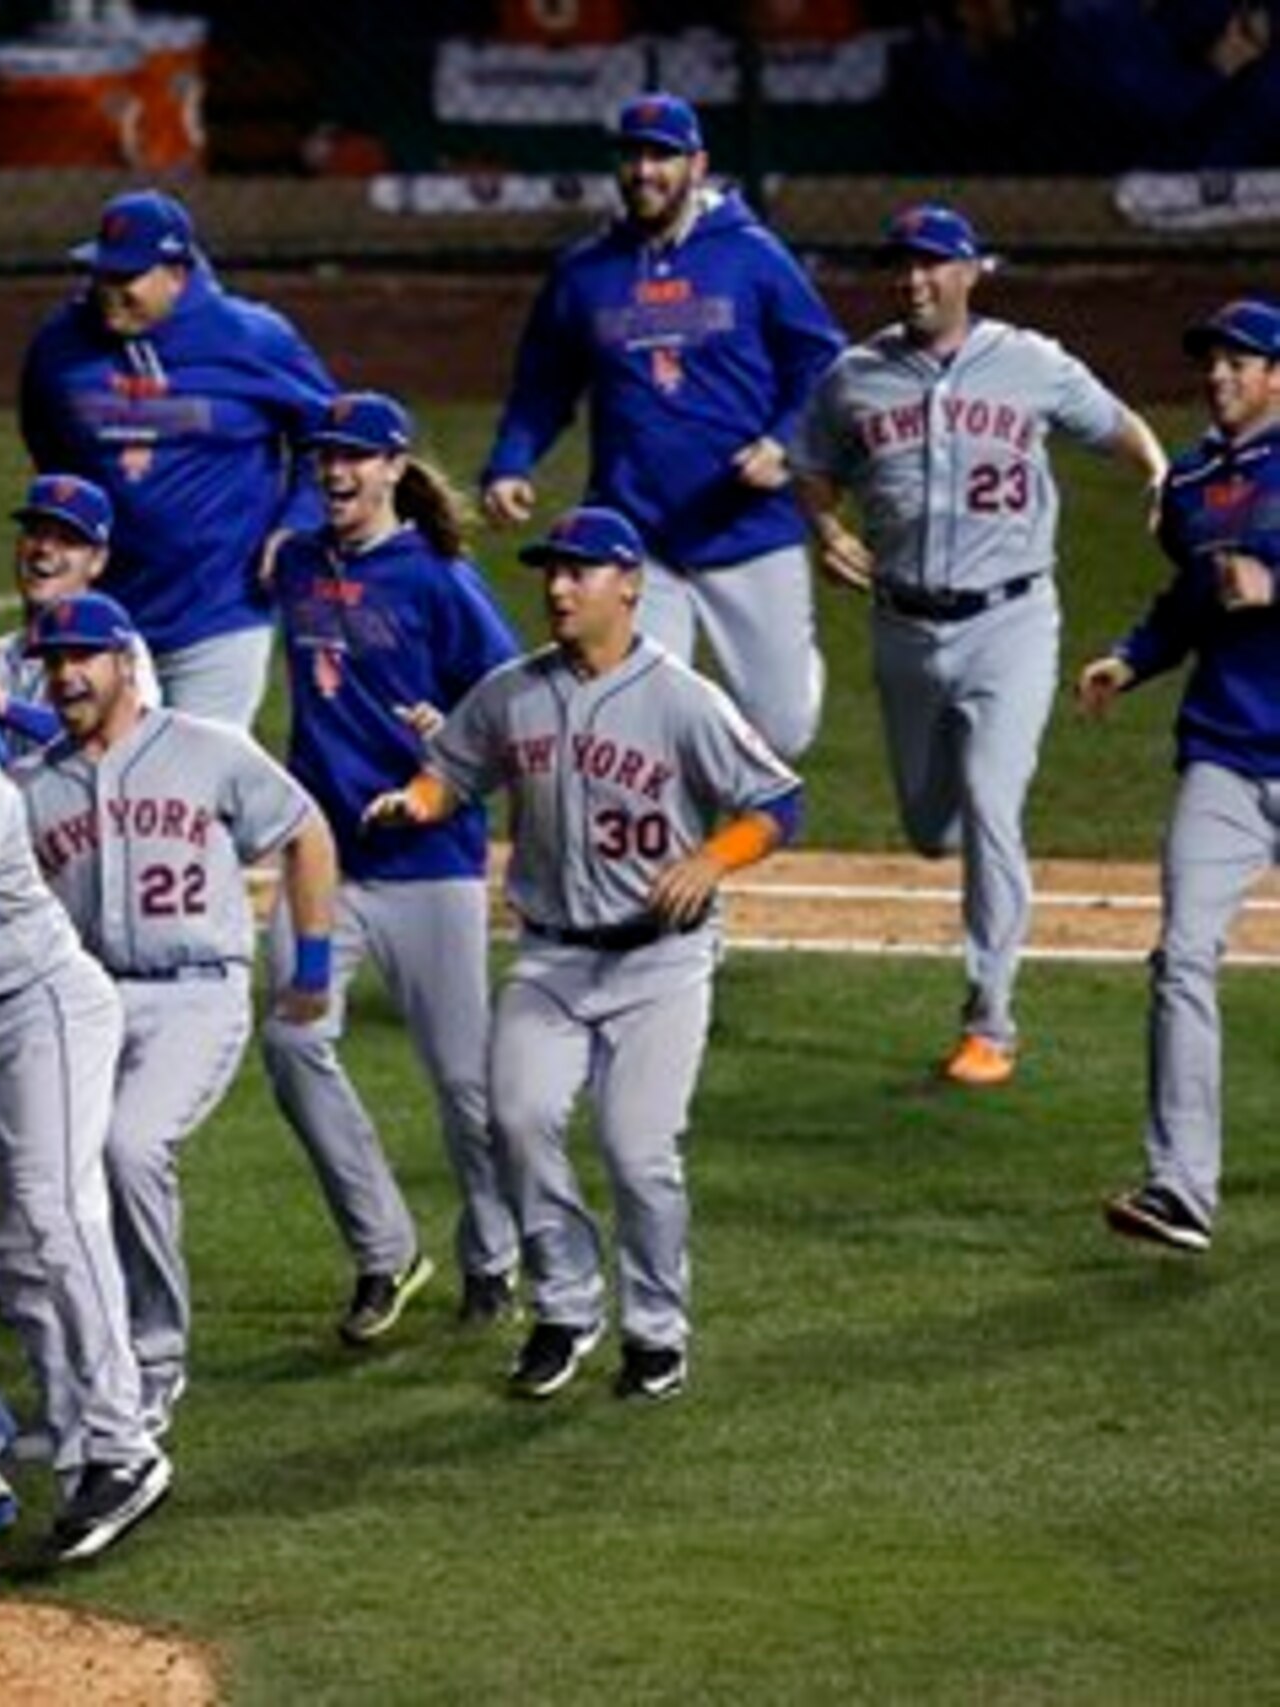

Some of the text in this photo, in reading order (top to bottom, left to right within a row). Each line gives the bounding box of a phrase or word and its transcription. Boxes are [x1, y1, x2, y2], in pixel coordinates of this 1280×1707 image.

[967, 462, 1030, 513] 23
[572, 733, 673, 801] YORK
[106, 798, 212, 849] YORK
[594, 808, 670, 861] 30
[138, 862, 208, 917] 22
